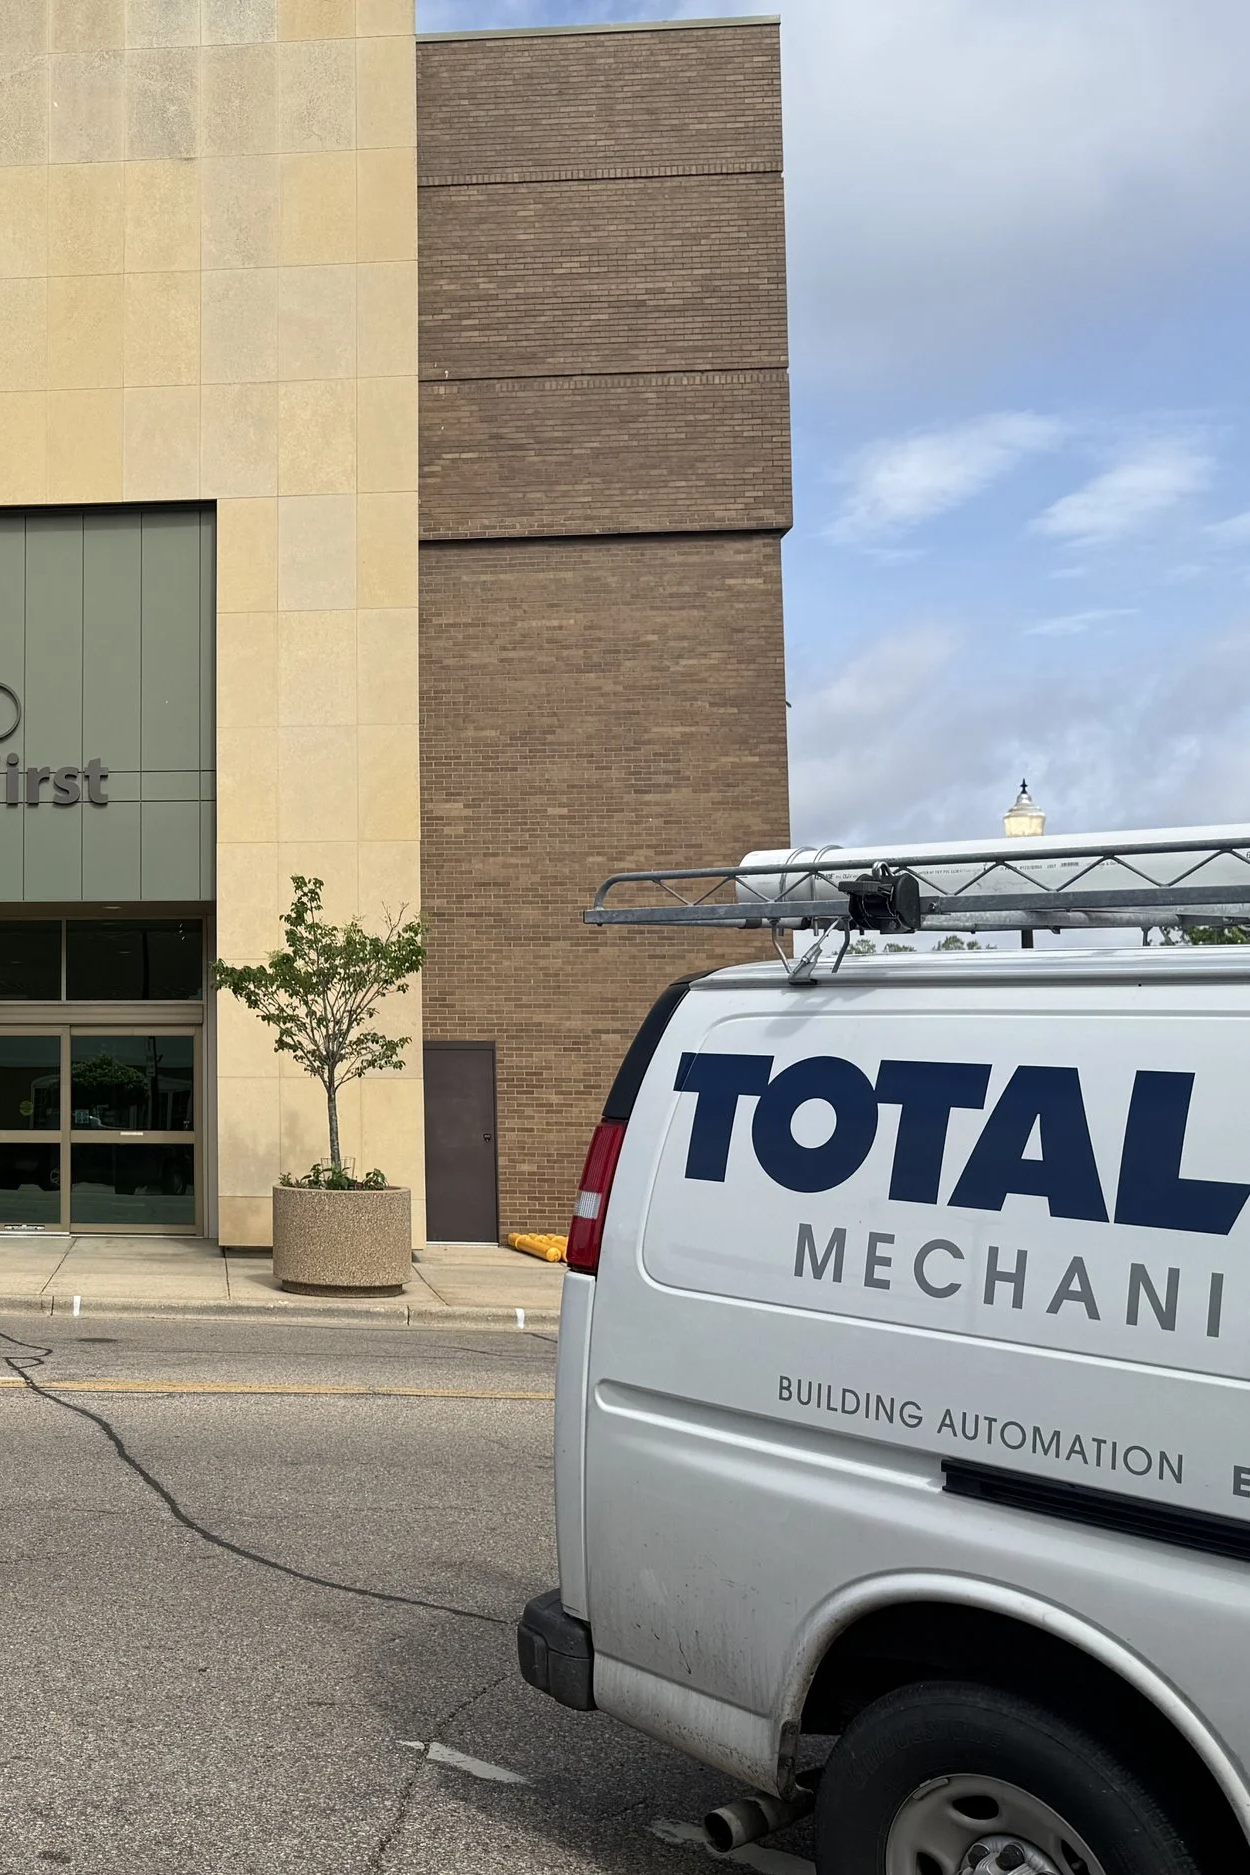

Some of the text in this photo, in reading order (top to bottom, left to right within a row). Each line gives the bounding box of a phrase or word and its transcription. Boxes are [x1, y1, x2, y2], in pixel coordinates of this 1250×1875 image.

[673, 1051, 1250, 1236] TOTAL
[793, 1222, 1224, 1339] MECHANI
[778, 1375, 924, 1429] BUILDING
[937, 1408, 1184, 1484] AUTOMATION
